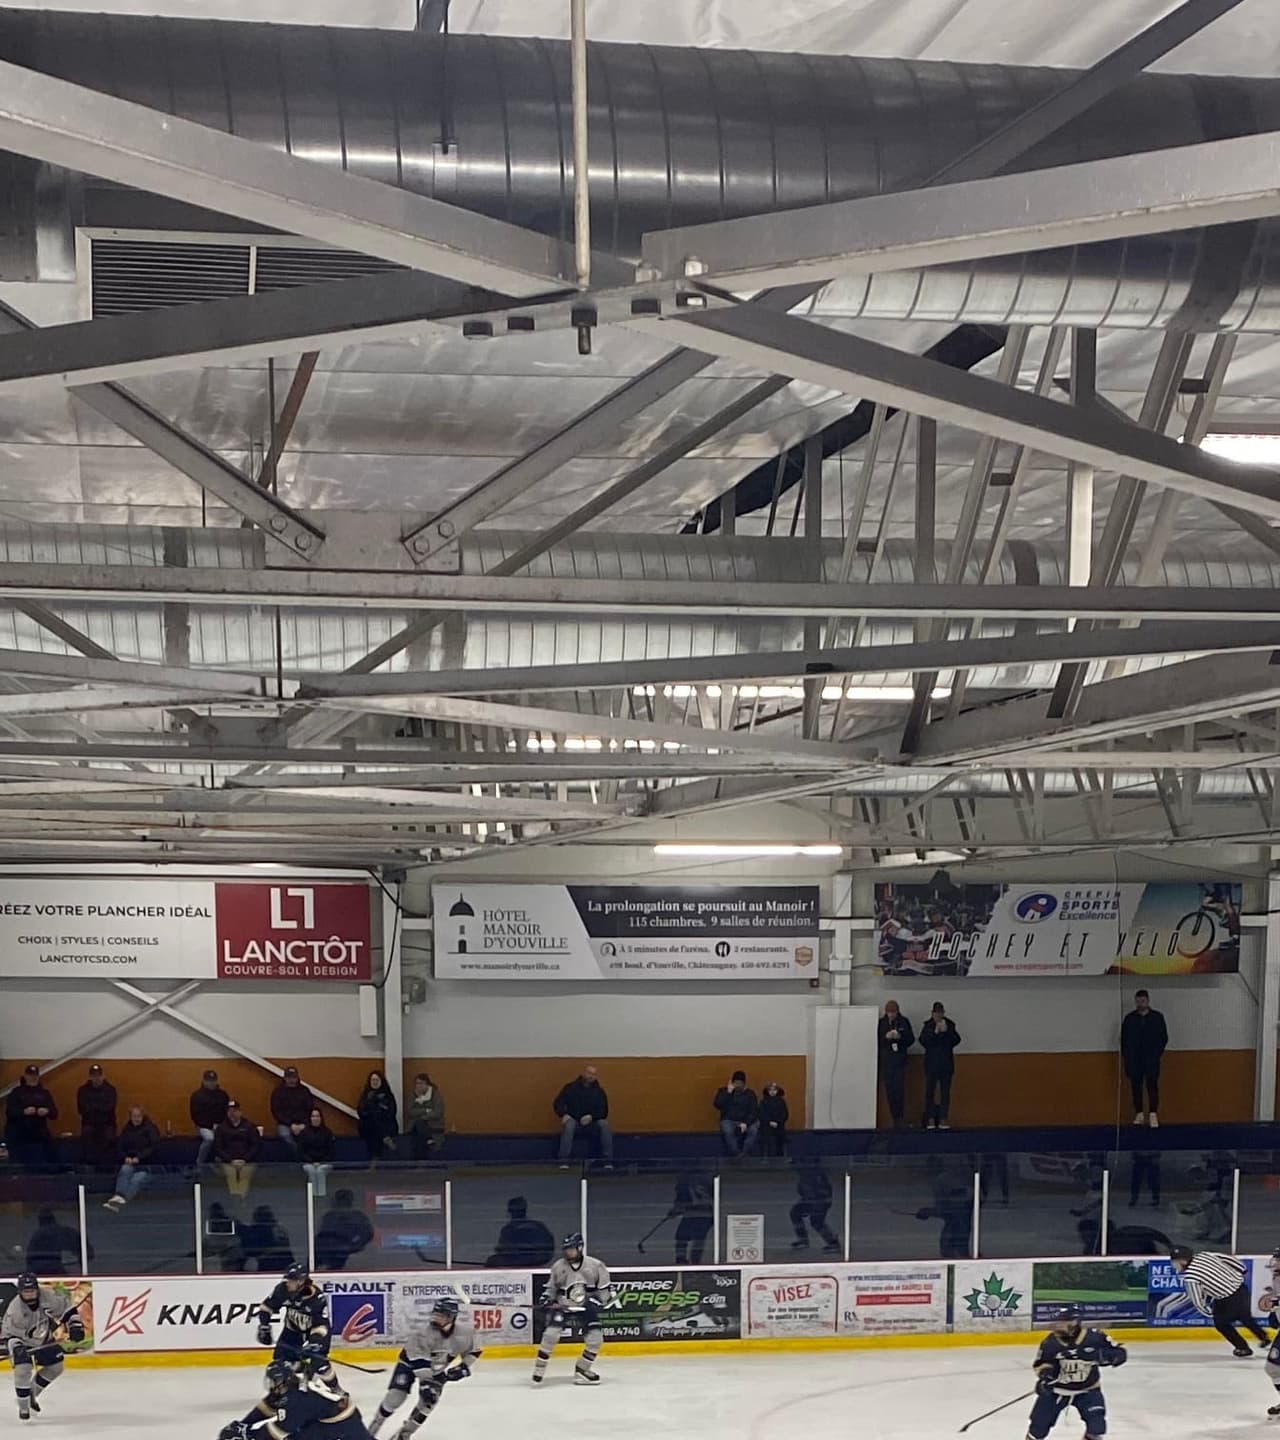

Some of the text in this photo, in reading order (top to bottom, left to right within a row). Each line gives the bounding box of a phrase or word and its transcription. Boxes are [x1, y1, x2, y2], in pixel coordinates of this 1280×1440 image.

[35, 905, 83, 916] VOTRE
[88, 906, 165, 917] PLANCHER
[169, 905, 212, 918] IDÉAL
[588, 900, 602, 911] La
[605, 900, 680, 914] prolongation
[683, 902, 696, 911] se
[698, 900, 746, 914] poursuit
[749, 902, 763, 911] au
[766, 900, 809, 911] Manoir
[1062, 900, 1120, 911] SPORTS
[483, 908, 530, 921] HÔTEL
[1059, 911, 1117, 921] Excellence
[629, 915, 815, 927] 115 chambres. 9 salles de réunion.
[483, 924, 541, 935] MANOIR
[18, 936, 159, 946] CHOIX STYLES CONSEILS
[484, 937, 568, 949] D'YOUVILLE
[928, 929, 1179, 960] HOCKEY ET VÉLO
[223, 935, 363, 964] LANCTÔT
[39, 955, 137, 964] LANCTOTCSD.COM
[224, 965, 358, 976] COUVRE-SOL DESIGN
[322, 1281, 396, 1293] ÉNAULT
[402, 1283, 526, 1296] ENTREPRENR ÉLECTRICIEN
[773, 1284, 812, 1303] VISEZ
[473, 1310, 503, 1330] 5152
